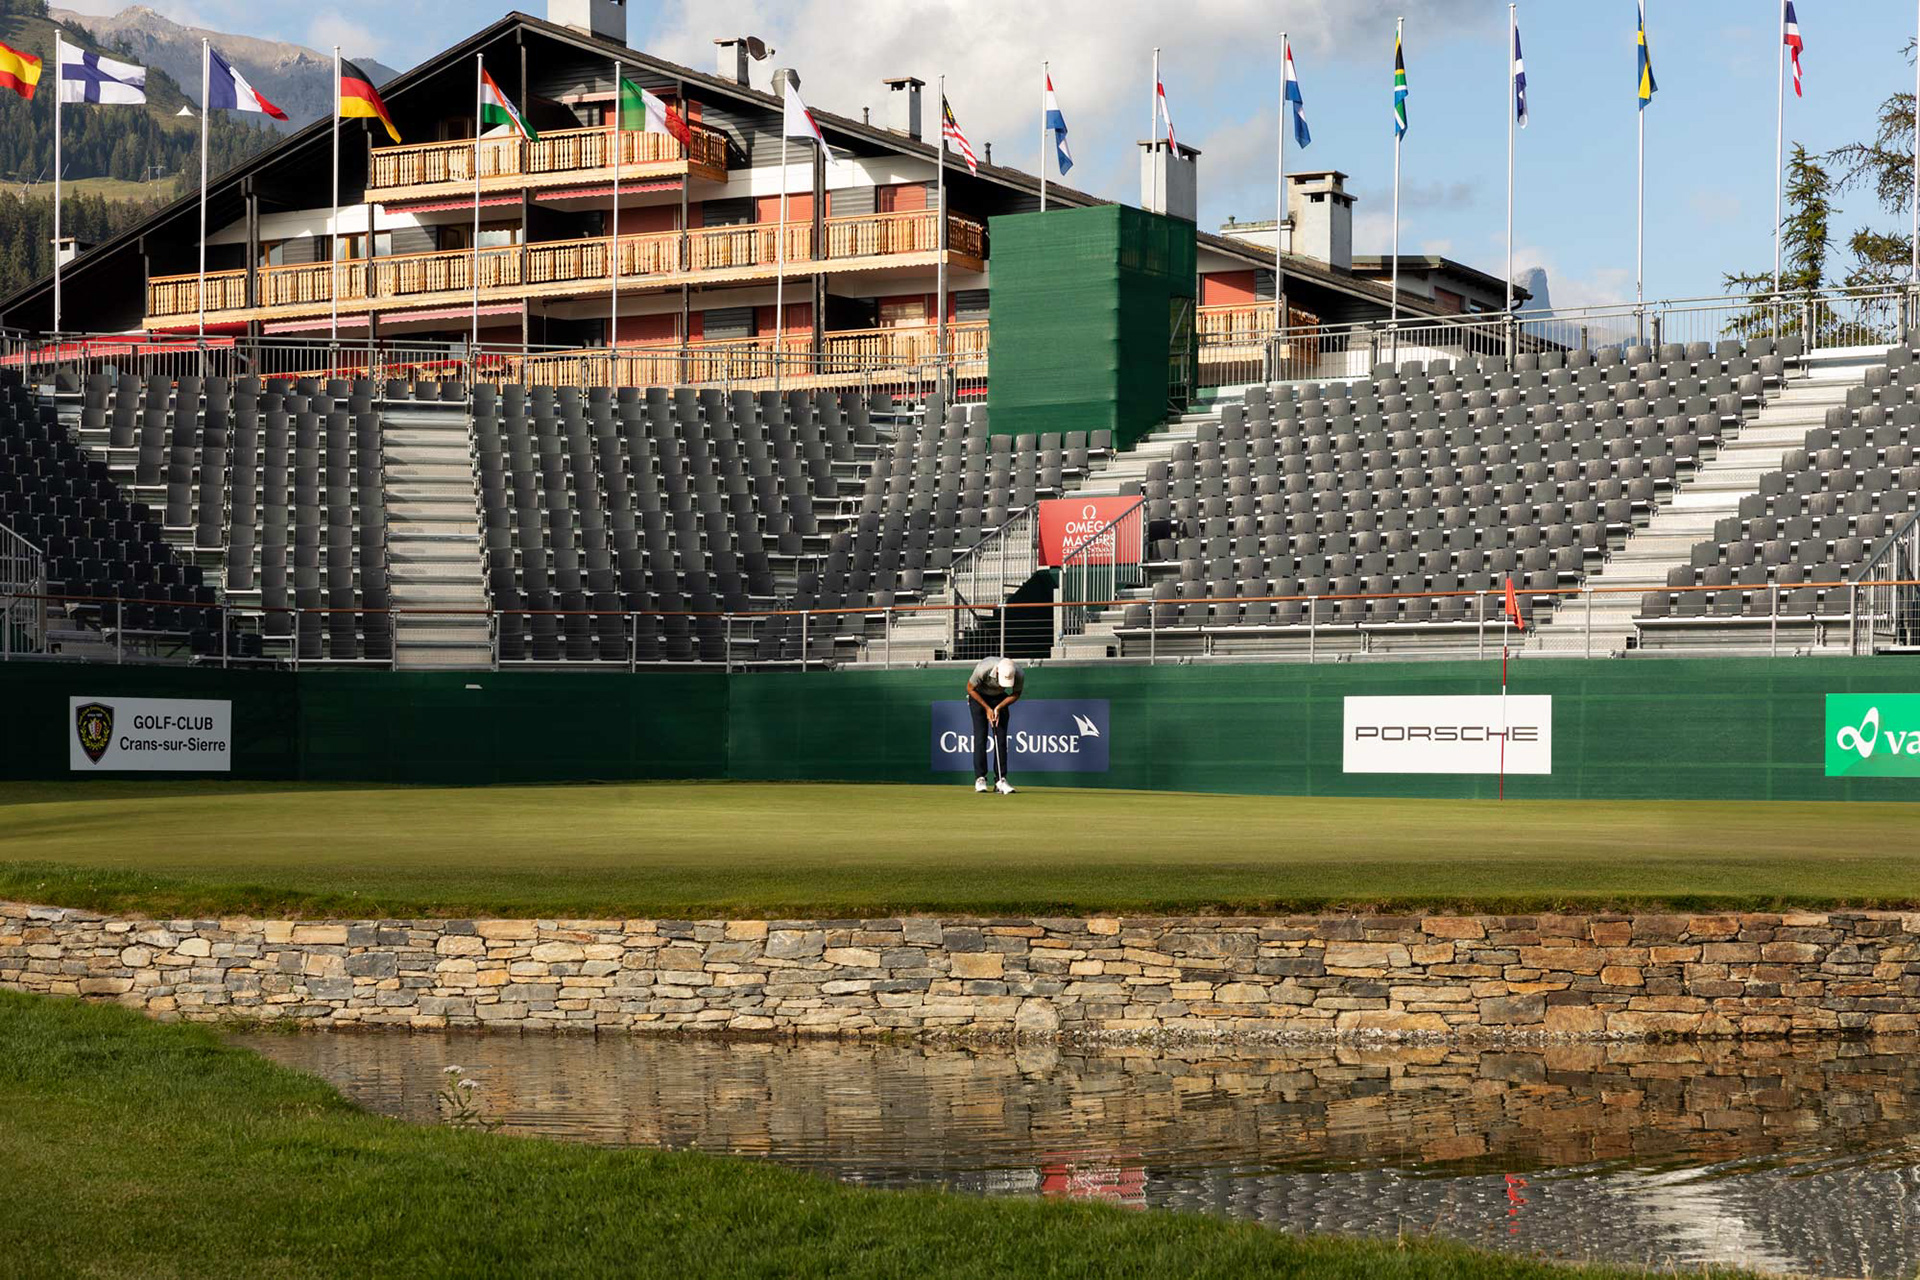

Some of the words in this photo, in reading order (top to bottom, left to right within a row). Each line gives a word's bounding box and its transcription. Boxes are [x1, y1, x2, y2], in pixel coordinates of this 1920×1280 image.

[133, 715, 213, 730] GOLF-CLUB
[1355, 726, 1538, 741] PORSCHE
[119, 736, 226, 752] Crans-sur-Sierre
[1015, 731, 1080, 753] SUISSE
